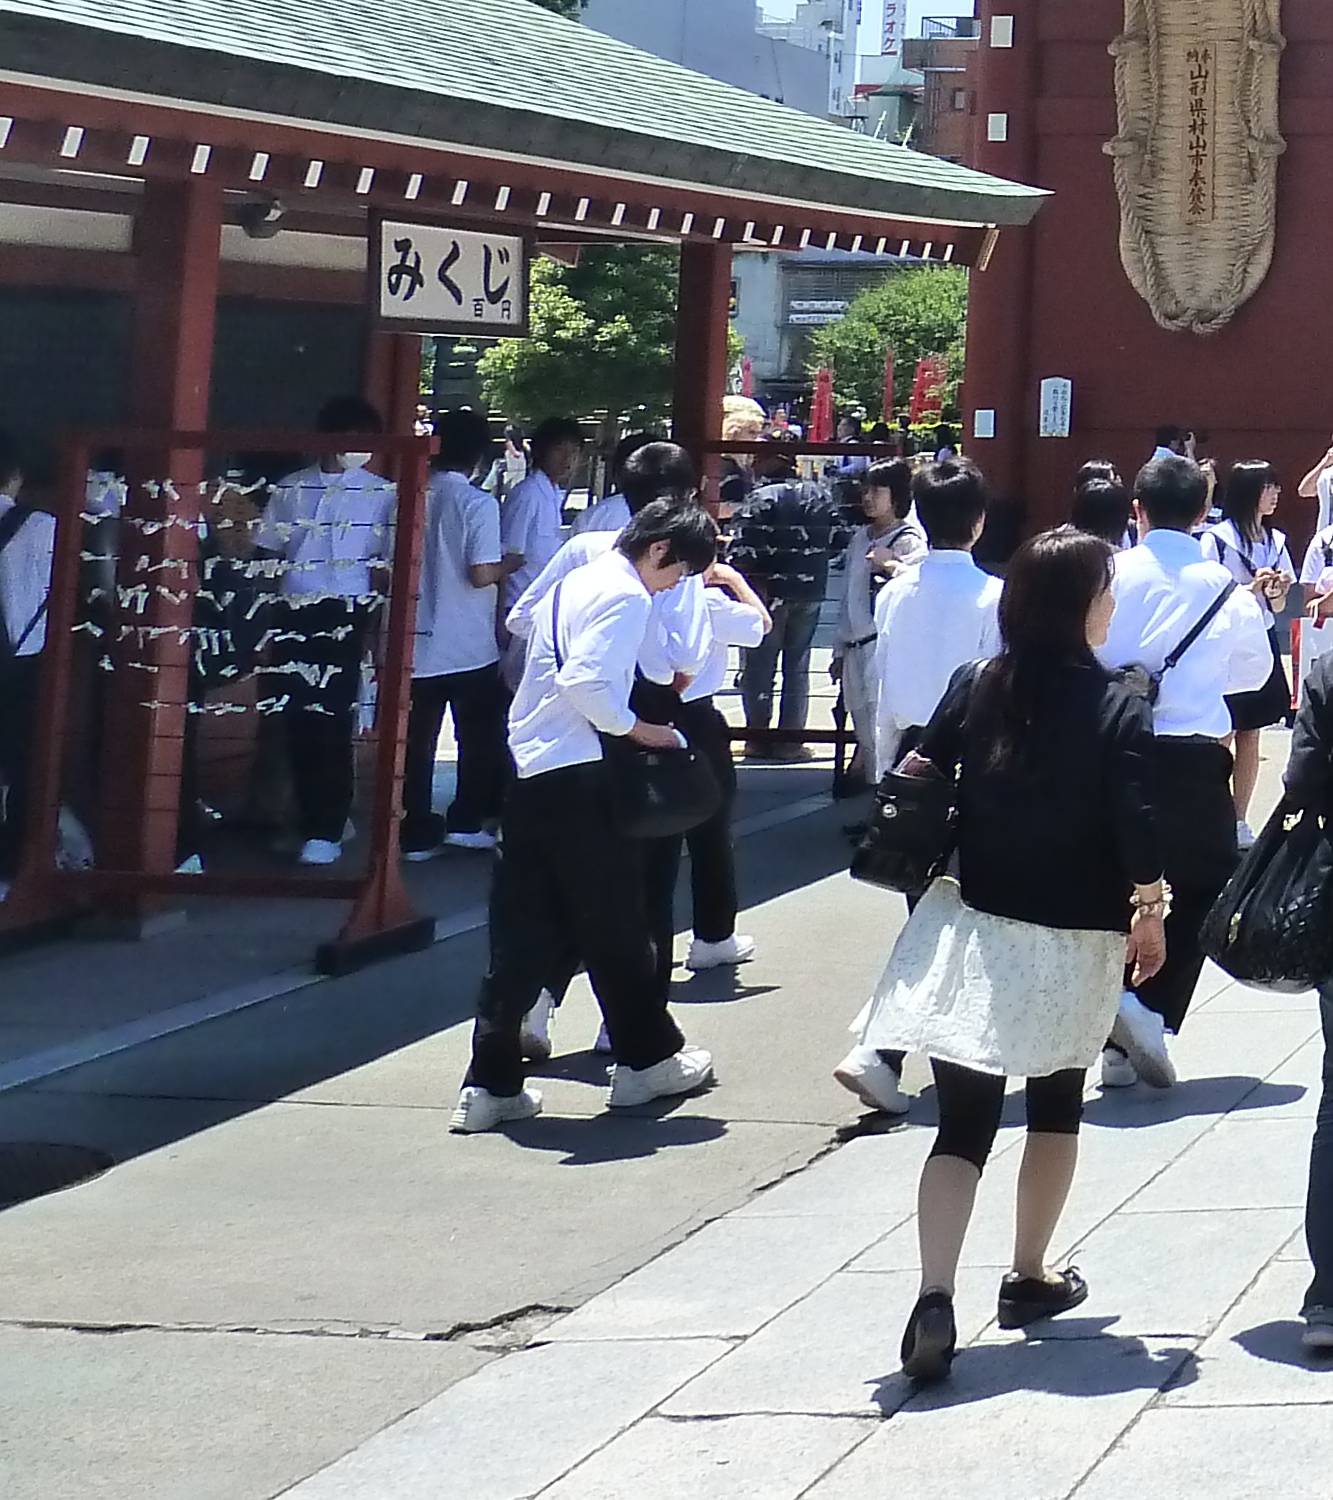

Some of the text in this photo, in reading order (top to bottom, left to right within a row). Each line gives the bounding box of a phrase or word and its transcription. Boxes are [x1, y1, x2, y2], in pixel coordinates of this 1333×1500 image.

[388, 238, 510, 305] みくじ
[472, 298, 511, 320] 百円
